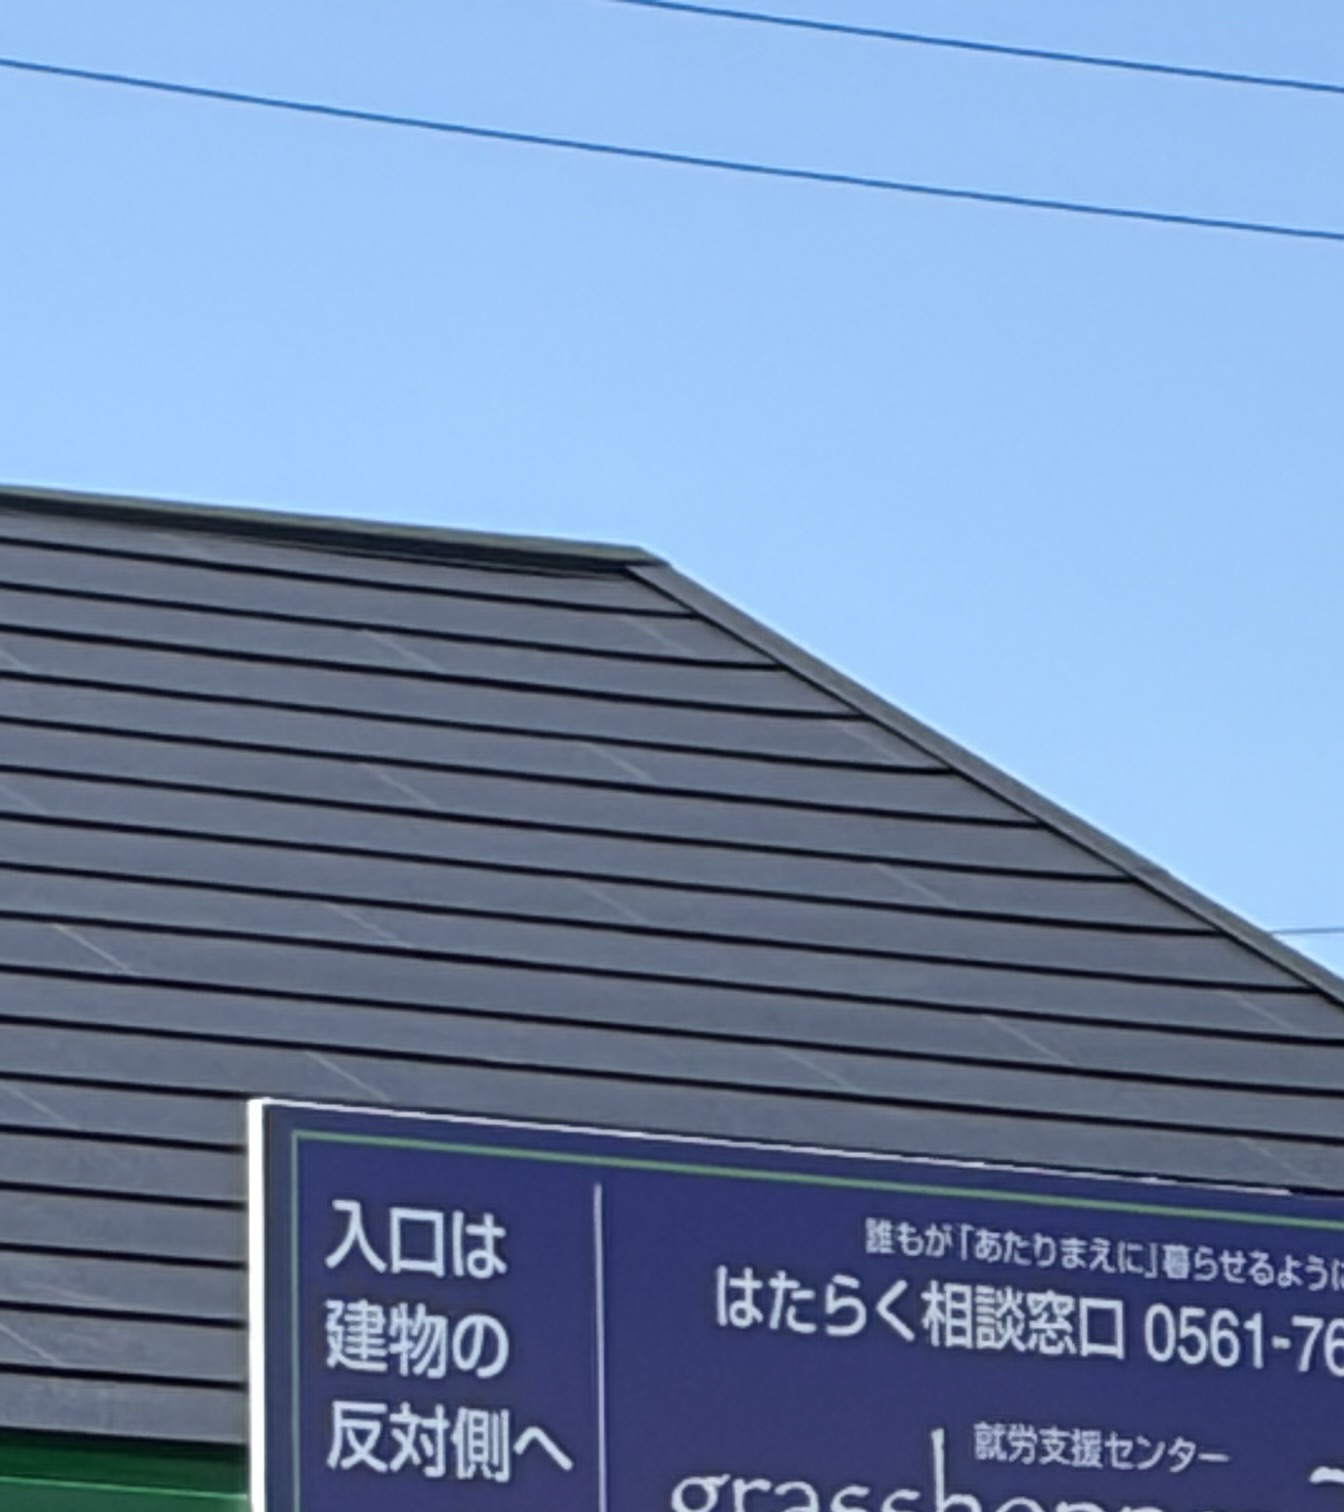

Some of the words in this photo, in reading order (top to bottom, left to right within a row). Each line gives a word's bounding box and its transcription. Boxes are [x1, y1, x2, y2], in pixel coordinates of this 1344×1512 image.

[325, 1200, 508, 1280] 入口は
[324, 1300, 509, 1379] 建物の
[716, 1265, 1124, 1360] はたらく相談窓口
[326, 1401, 574, 1482] 反対側へ
[973, 1421, 1230, 1473] 就労支援センター
